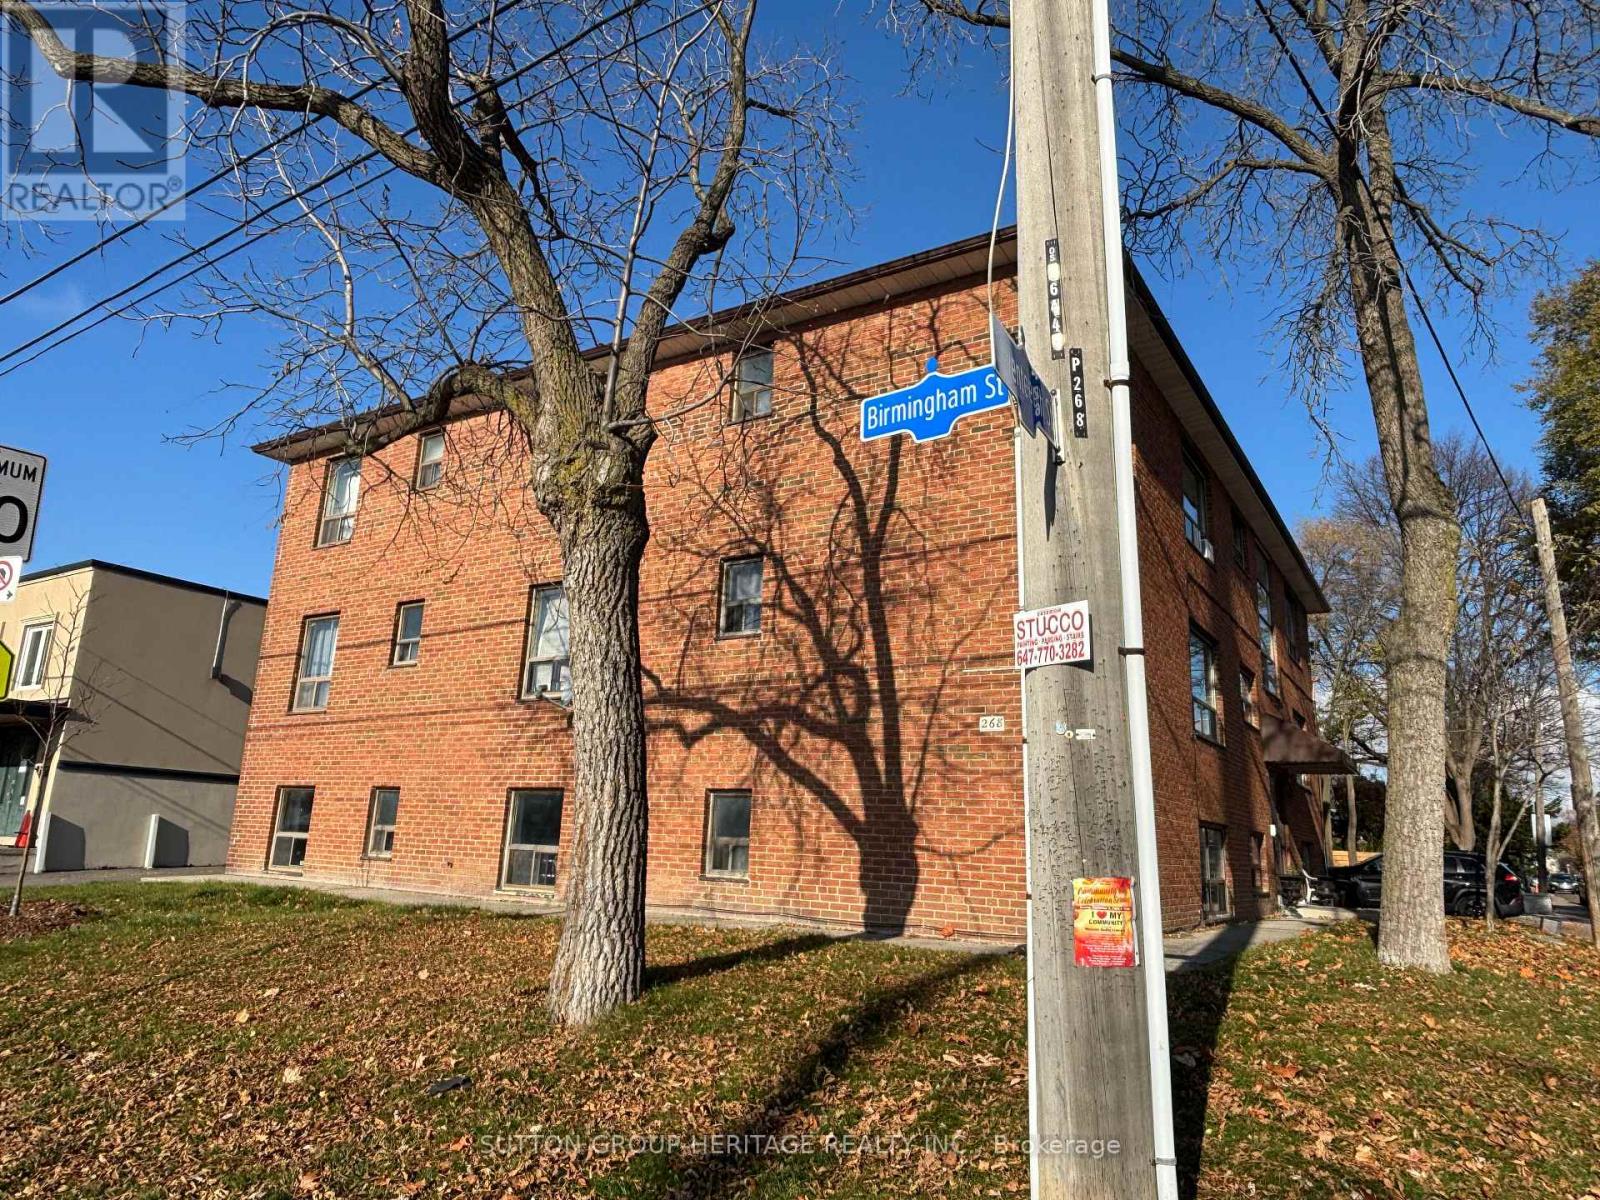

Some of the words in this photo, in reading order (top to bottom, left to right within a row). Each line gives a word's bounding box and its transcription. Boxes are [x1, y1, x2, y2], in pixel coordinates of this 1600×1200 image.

[867, 384, 977, 430] Birmingham
[985, 373, 1004, 399] St
[1017, 610, 1084, 640] STUCCO
[981, 717, 1003, 728] 268
